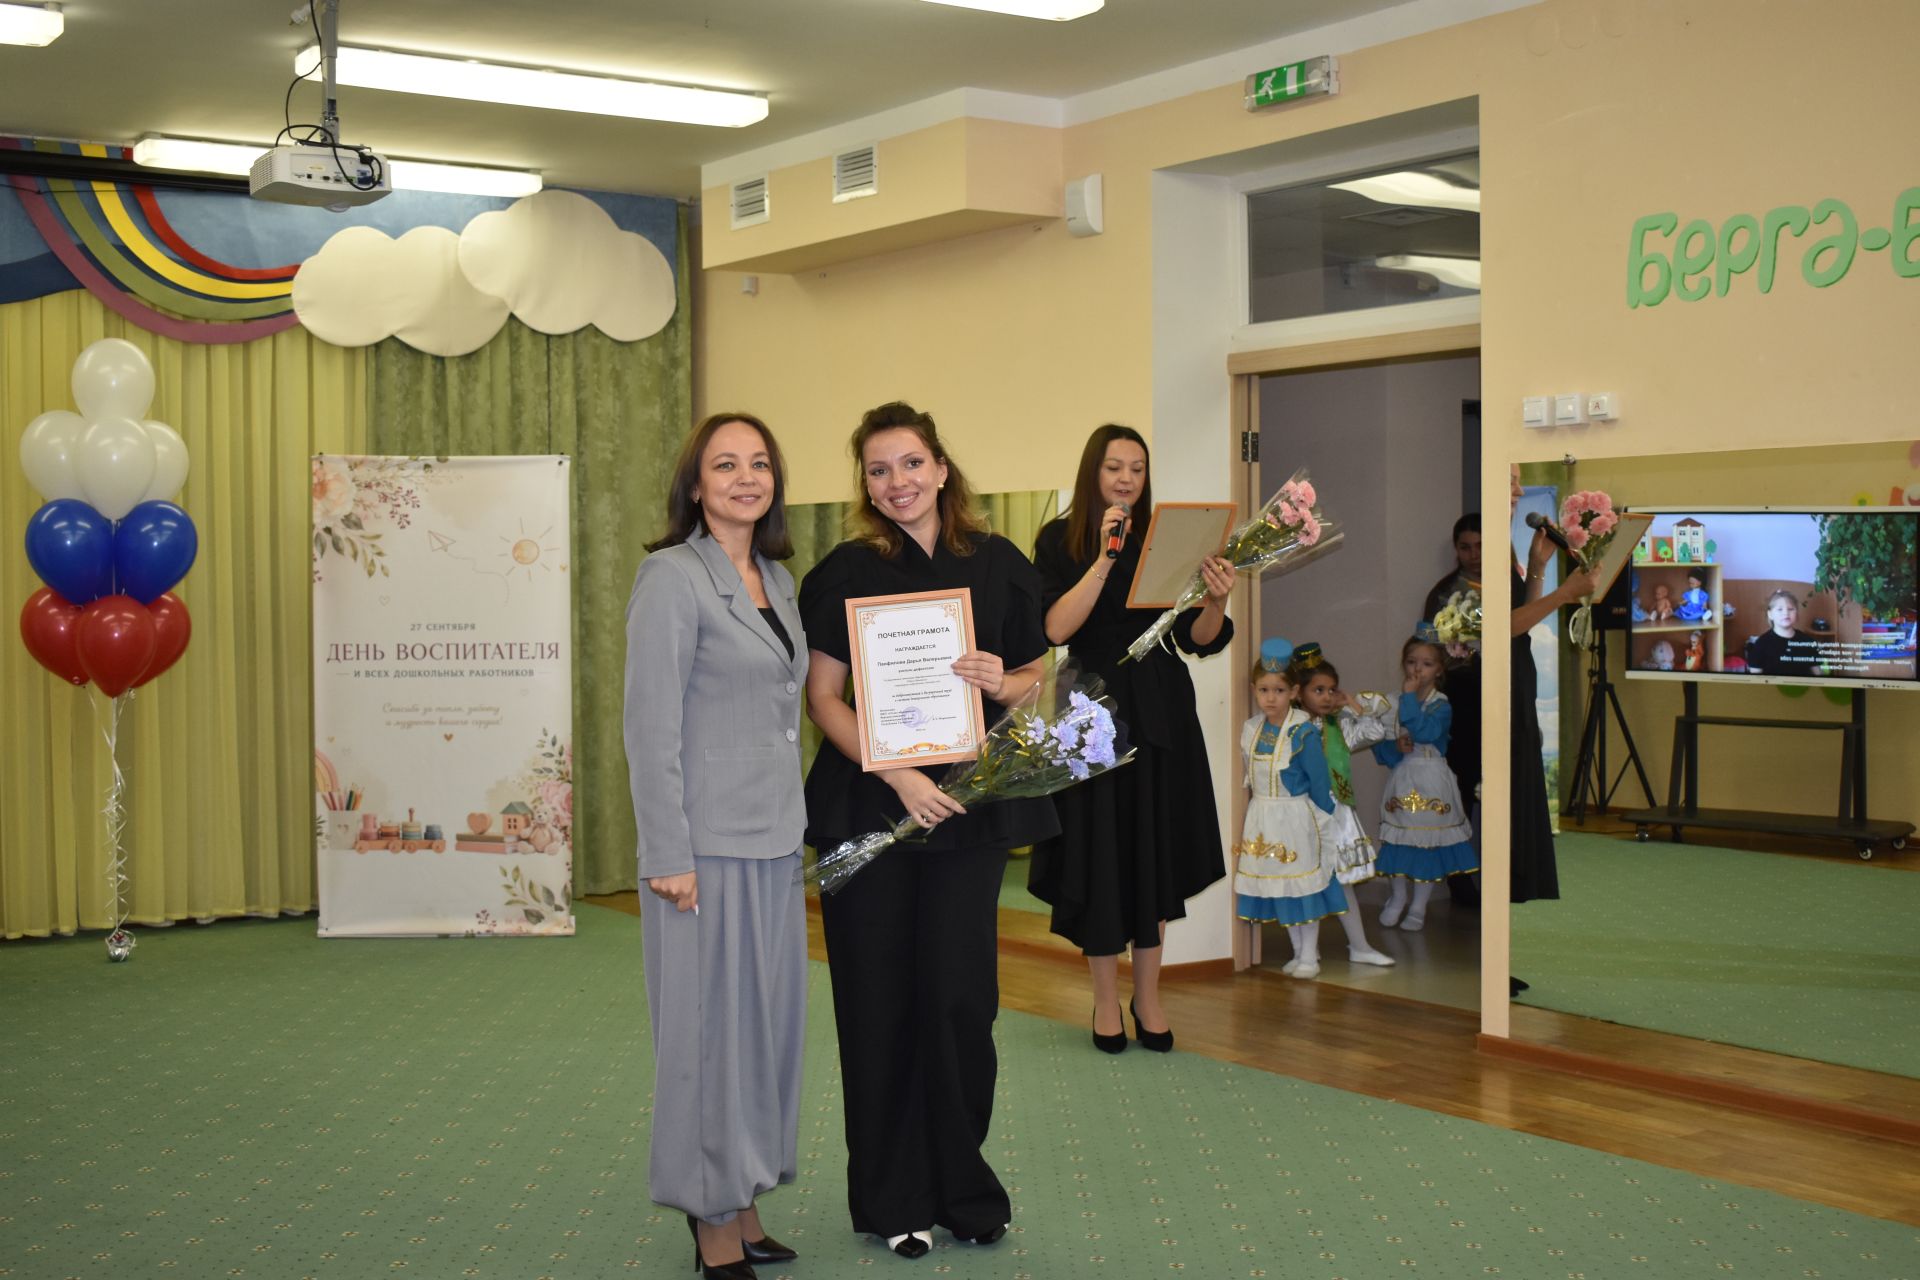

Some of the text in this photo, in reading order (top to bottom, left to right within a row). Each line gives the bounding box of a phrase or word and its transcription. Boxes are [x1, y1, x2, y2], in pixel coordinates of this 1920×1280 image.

[426, 623, 476, 631] СЕНТЯБРЯ
[878, 626, 950, 639] ПОЧЕТНАЯ ГРАМОТА
[326, 642, 560, 663] ДЕНЬ ВОСПИТАТЕЛЯ
[894, 644, 936, 652] НАГРАЖДАЕТСЯ
[364, 670, 390, 678] ВСЕХ
[394, 670, 464, 678] ДОШКОЛЬНЫХ
[469, 669, 535, 678] РАБОТНИКОВ
